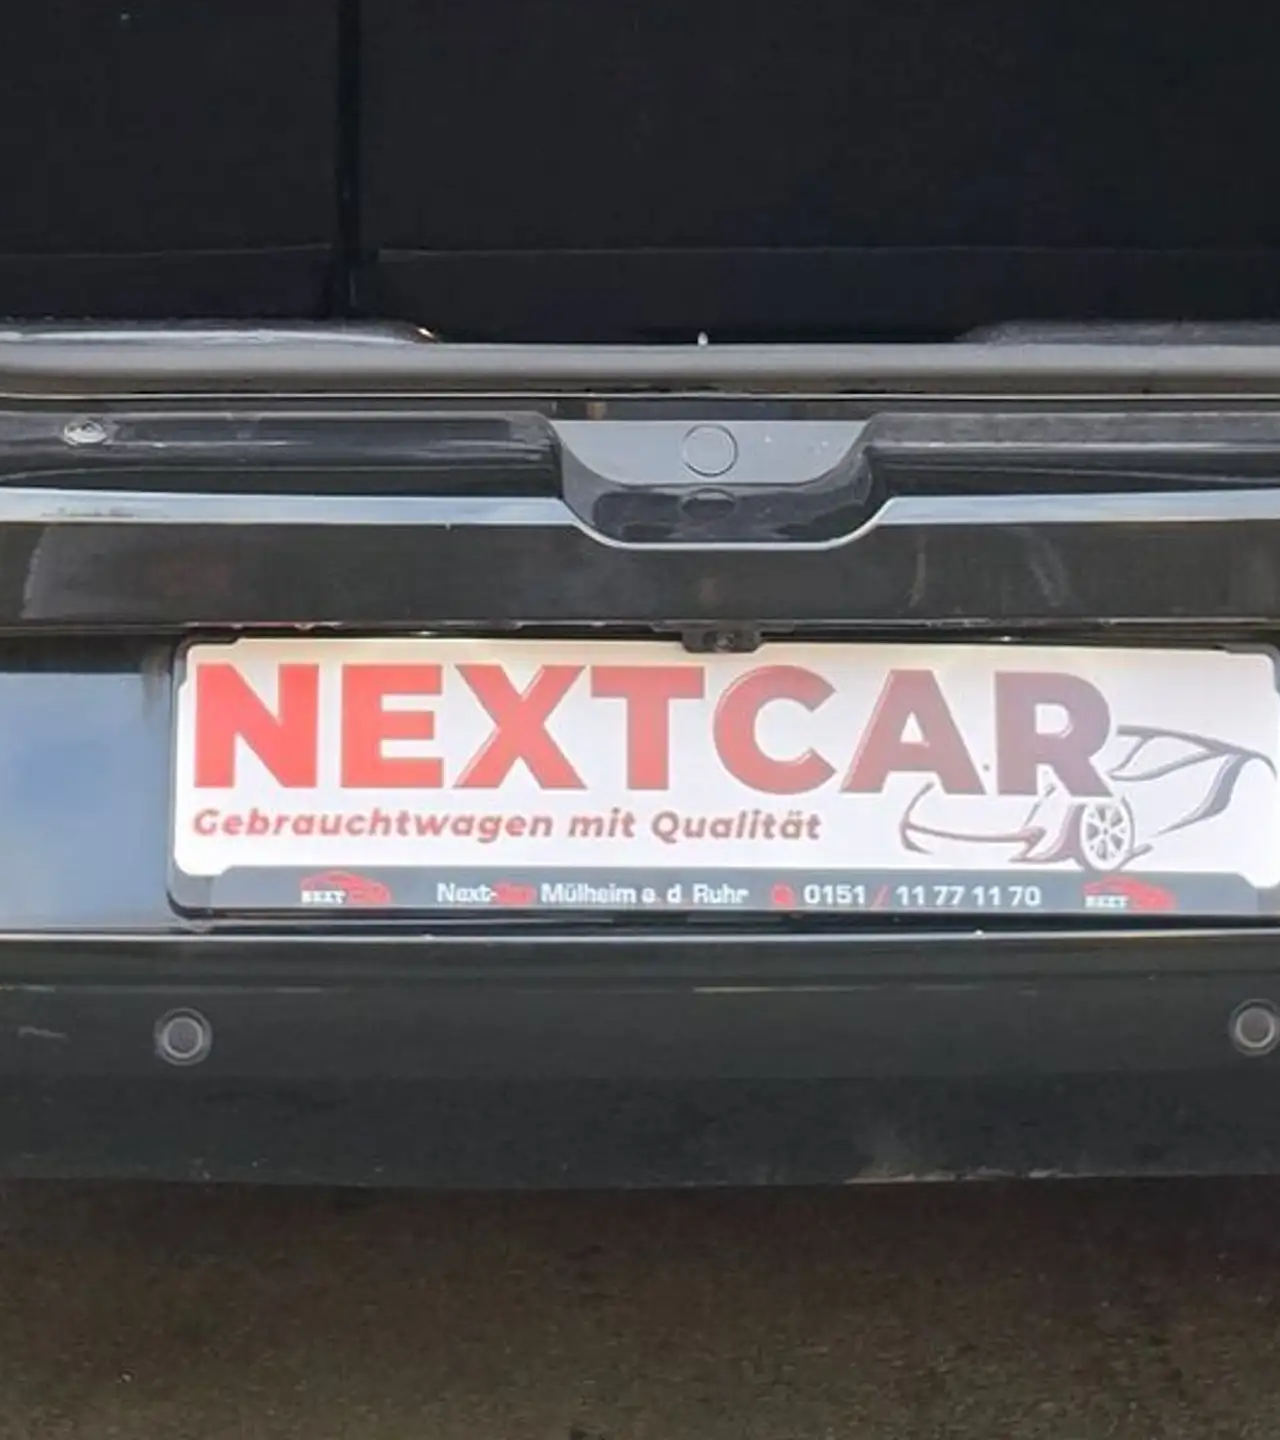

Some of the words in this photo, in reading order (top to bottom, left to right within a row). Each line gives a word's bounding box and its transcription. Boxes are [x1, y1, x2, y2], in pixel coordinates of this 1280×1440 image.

[194, 663, 1114, 796] NEXTCAR
[192, 808, 553, 844] Gebrauchtwagen
[567, 807, 636, 838] mit
[650, 810, 822, 842] Qualität
[540, 882, 636, 904] Mülheim
[693, 882, 749, 905] Ruhr
[803, 884, 866, 905] 0151
[896, 885, 925, 905] 11
[933, 885, 965, 906] 77
[972, 885, 1001, 906] 11
[1008, 886, 1041, 907] 70
